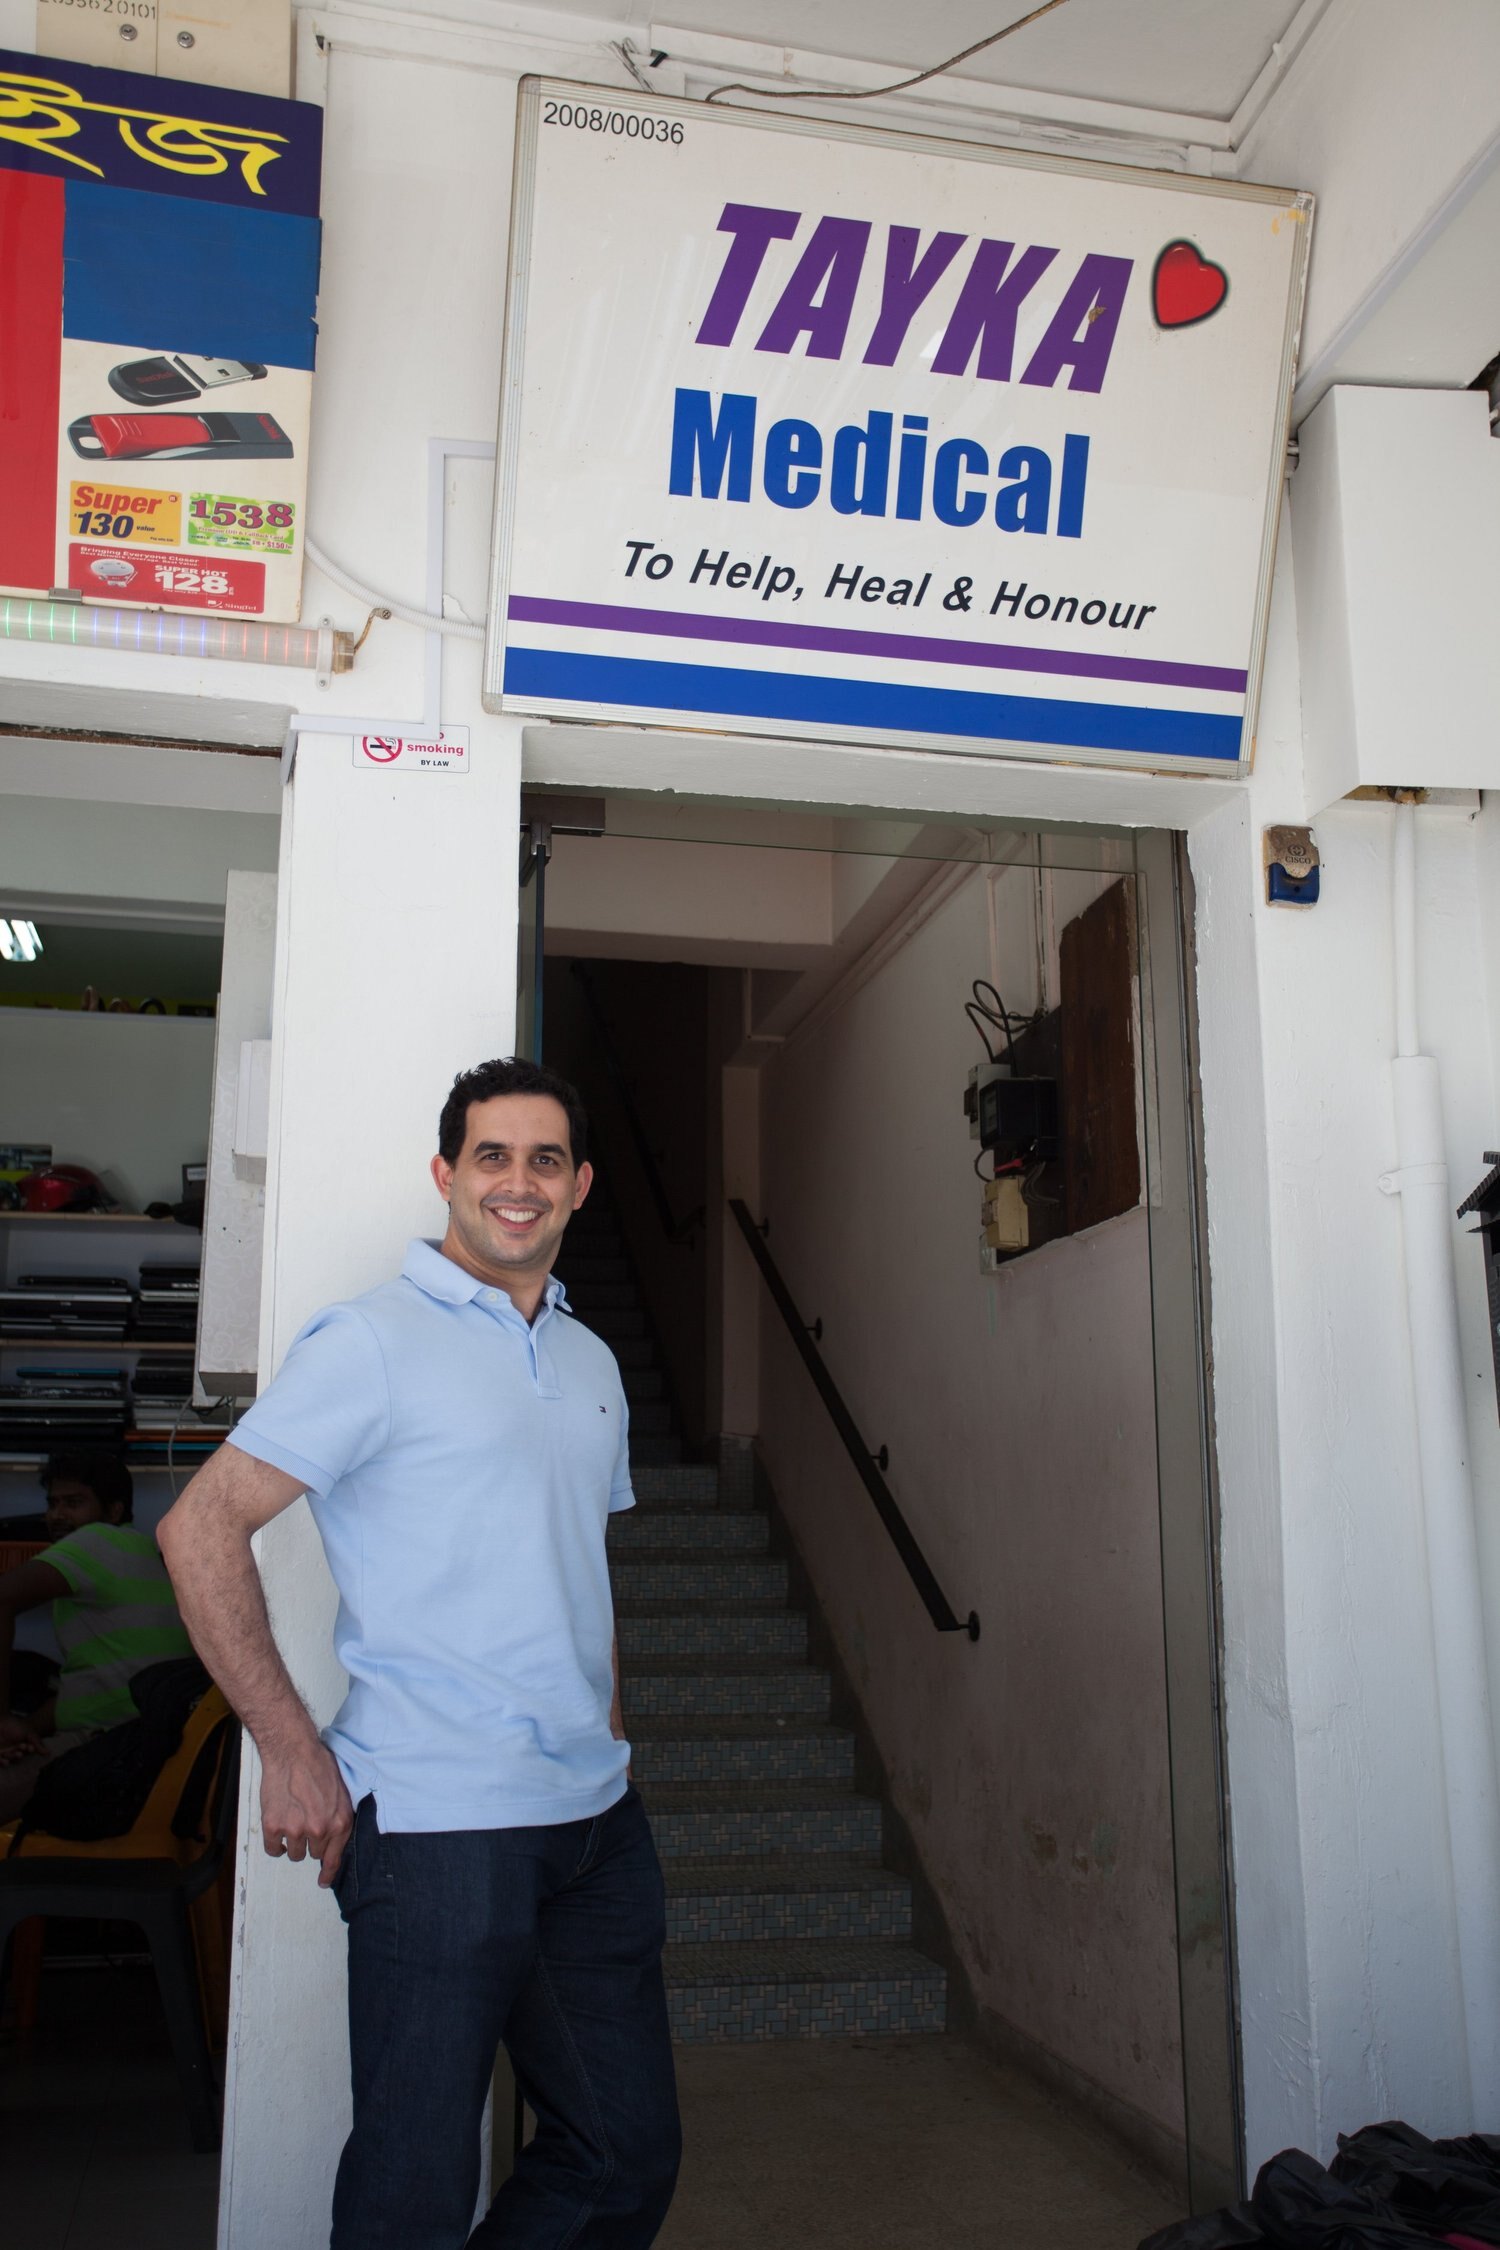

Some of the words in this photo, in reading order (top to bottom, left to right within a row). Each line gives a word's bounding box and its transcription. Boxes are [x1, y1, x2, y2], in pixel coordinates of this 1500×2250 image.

[544, 101, 685, 145] 2008/00036
[695, 202, 1135, 394] TAYKA
[669, 388, 1091, 539] Medical
[73, 485, 162, 515] Super
[190, 499, 294, 529] 1538
[80, 546, 121, 556] Bringing
[123, 550, 167, 561] Everyone
[168, 555, 200, 563] Closer
[155, 564, 199, 575] SUPER
[201, 569, 228, 577] HOT
[624, 540, 674, 581] To
[689, 548, 804, 602] Help,
[824, 563, 933, 608] Heal
[942, 576, 974, 613] &
[989, 580, 1157, 631] Honour
[407, 743, 464, 757] smoking
